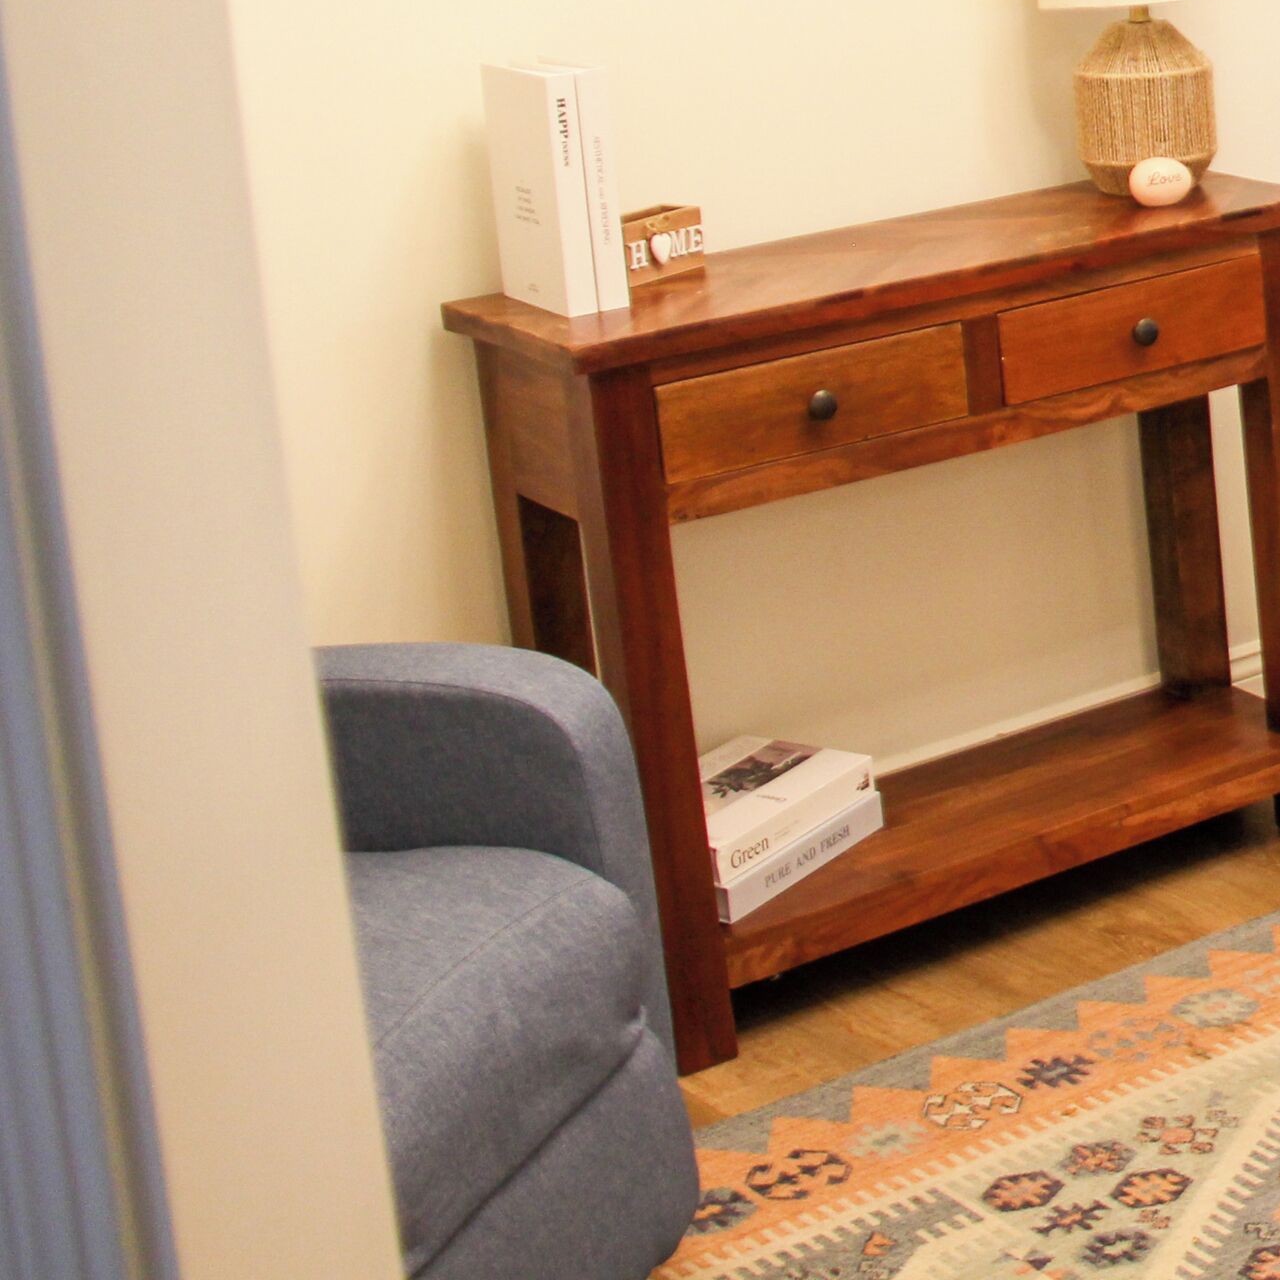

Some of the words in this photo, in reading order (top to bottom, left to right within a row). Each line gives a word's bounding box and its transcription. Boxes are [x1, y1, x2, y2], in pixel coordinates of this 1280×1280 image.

[730, 837, 769, 869] Green
[765, 863, 792, 887] PURE
[796, 847, 816, 867] AND
[820, 824, 850, 852] FRESH
